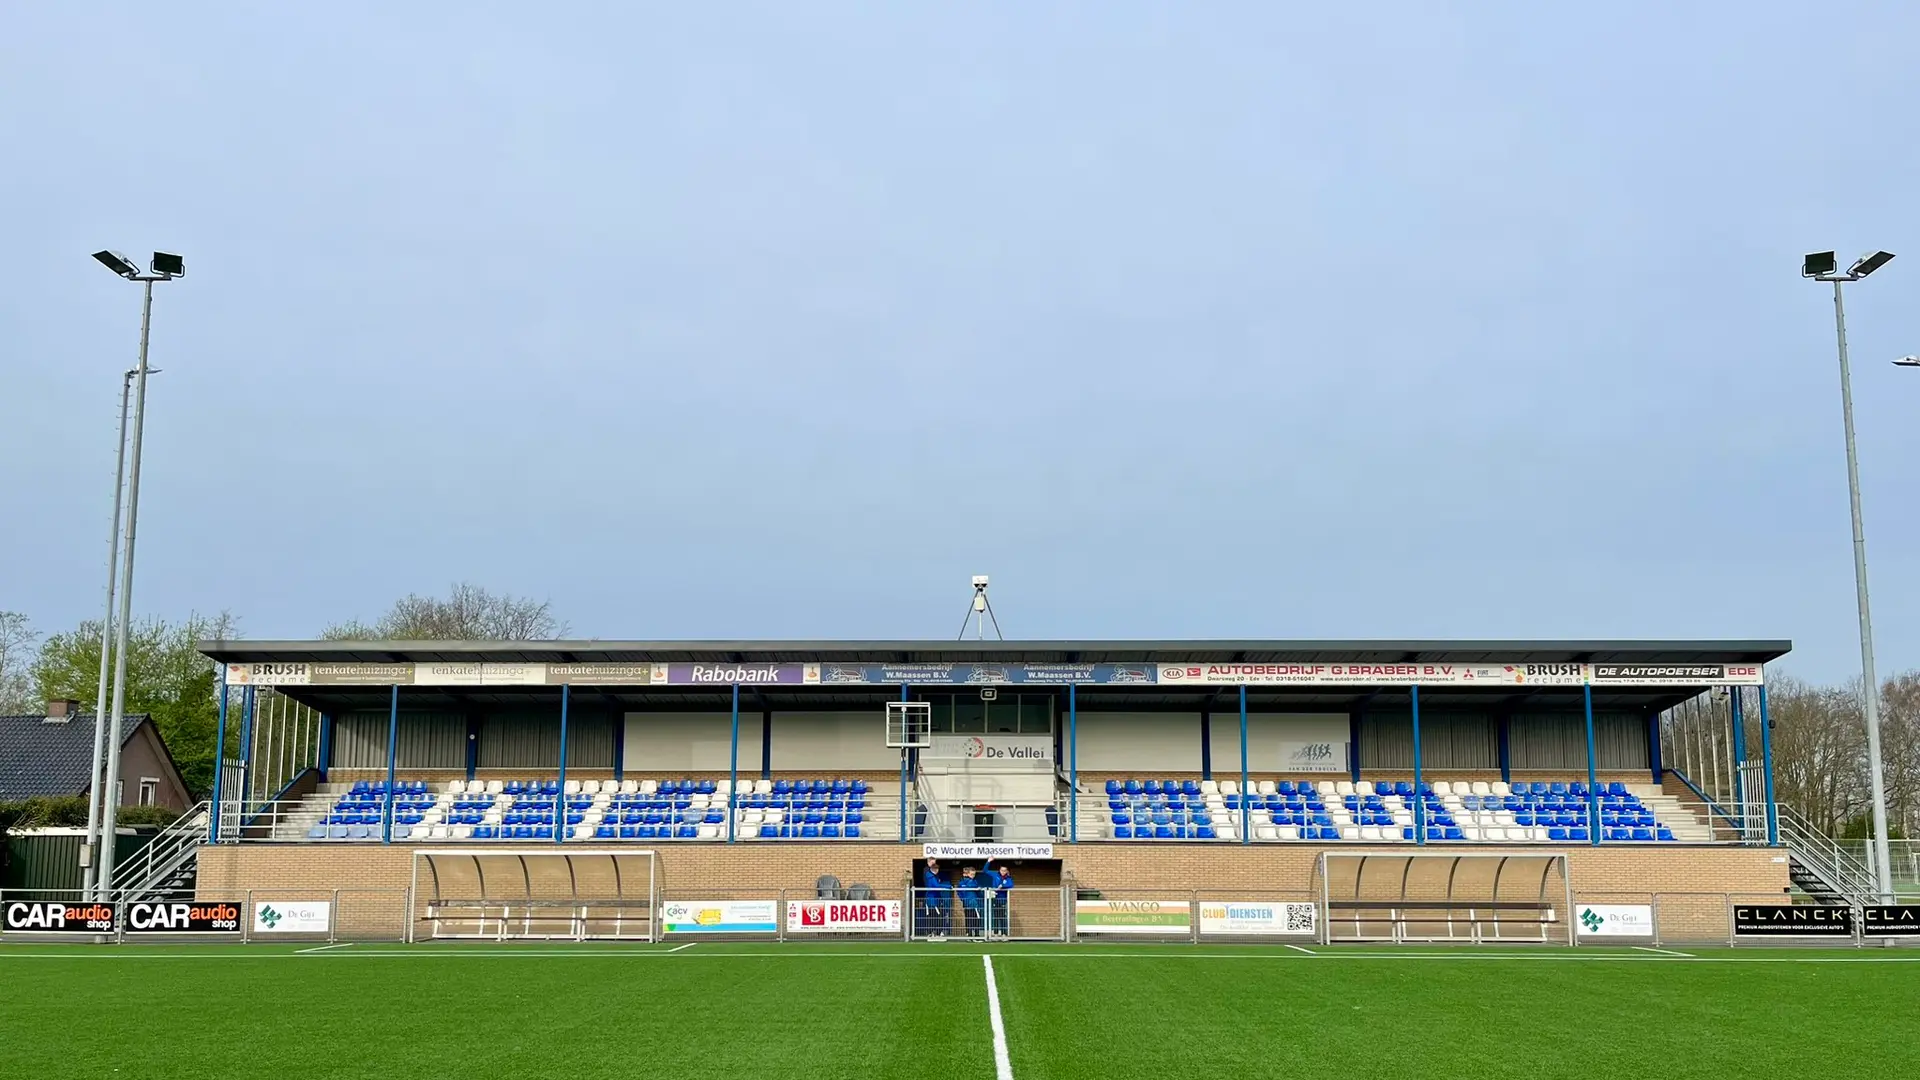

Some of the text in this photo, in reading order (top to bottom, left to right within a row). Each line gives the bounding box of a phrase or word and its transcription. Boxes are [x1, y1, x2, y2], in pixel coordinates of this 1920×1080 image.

[252, 664, 306, 675] BRUSH
[691, 665, 779, 682] Rabobank
[885, 671, 949, 679] W.Maassen B.V.
[1027, 671, 1091, 679] W.Maassen B.V.
[1207, 665, 1455, 674] AUTOBEDRIJF G.BRABER B.V.
[1527, 664, 1581, 675] BRUSH
[1598, 667, 1720, 676] DE AUTOPOETSER
[1728, 667, 1757, 676] EDE
[251, 676, 306, 684] reclame
[1527, 676, 1582, 684] reclame
[986, 747, 1044, 758] De Vallei
[925, 846, 1050, 855] De Wouter Maassen Tribune
[1108, 901, 1160, 912] WANCO
[7, 903, 111, 928] CAR audio
[130, 903, 236, 928] CAR audio
[830, 905, 886, 922] BRABER
[1202, 908, 1273, 919] CLUB DIENSTEN
[87, 919, 111, 930] shop
[212, 919, 236, 931] shop
